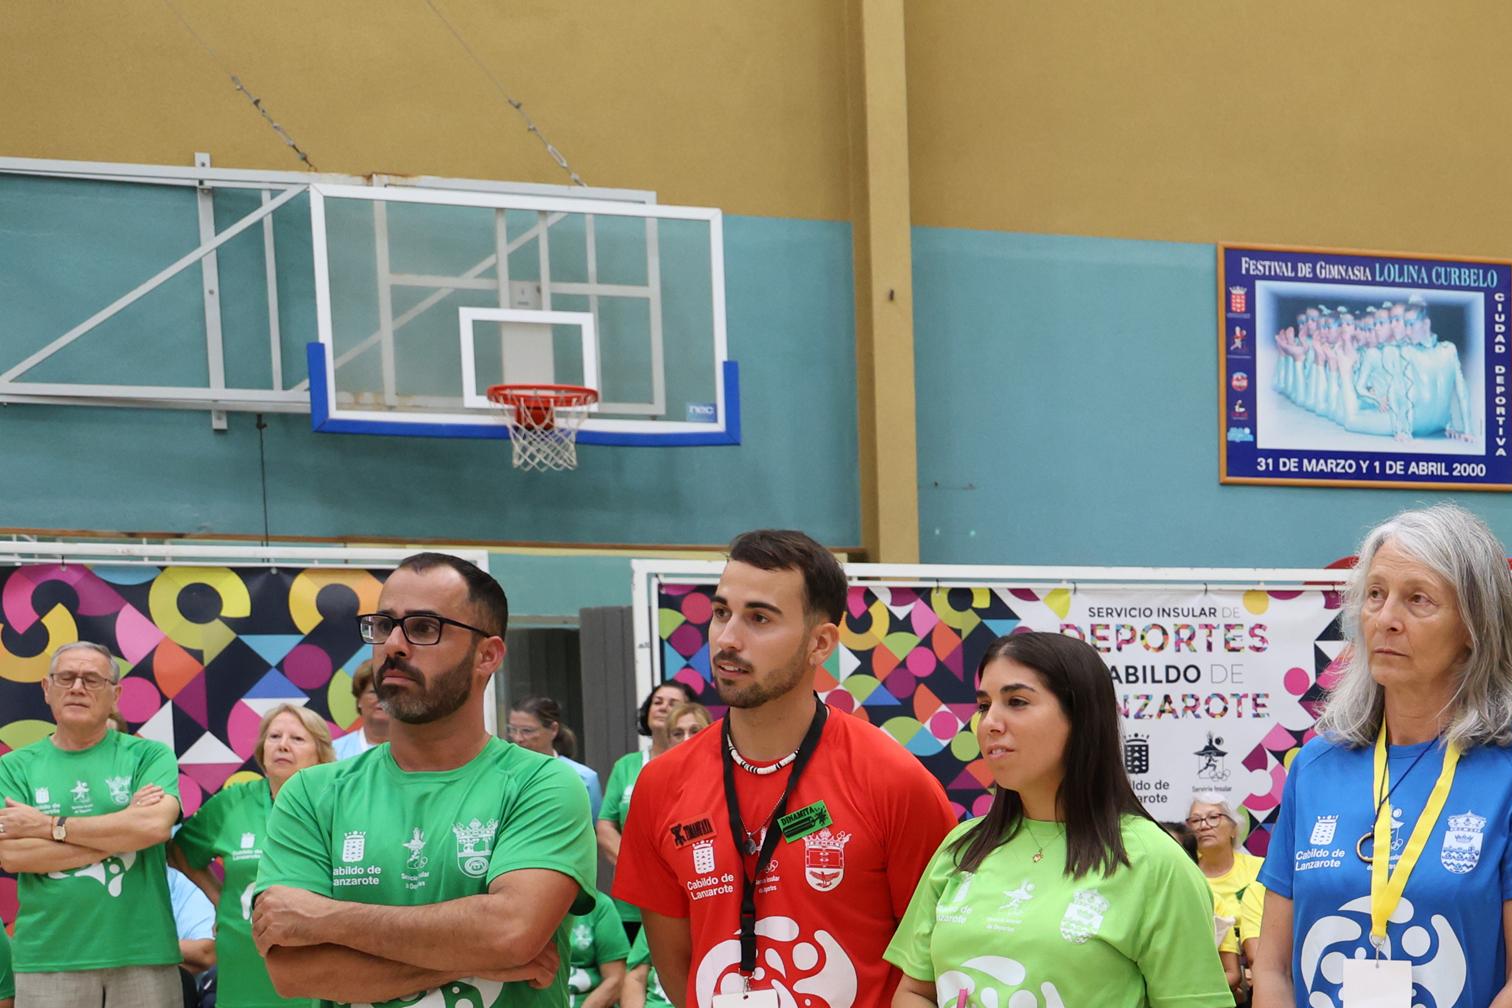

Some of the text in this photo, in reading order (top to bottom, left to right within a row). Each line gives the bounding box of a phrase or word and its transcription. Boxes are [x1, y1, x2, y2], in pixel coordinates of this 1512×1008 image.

[1241, 257, 1497, 288] FESTIVAL DE GIMNASIA LOLINA CURBELO
[1494, 293, 1507, 456] CIUDAD DEPORTIVA
[1256, 457, 1486, 477] 31 DE MARZO Y 1 DE ABRIL 2000
[1088, 607, 1241, 618] SERVICIO INSULAR DE
[1110, 664, 1244, 684] ABILDO DE
[1154, 780, 1170, 790] de
[1295, 848, 1345, 860] Cabildo de
[333, 865, 381, 876] abildo de
[1295, 860, 1341, 871] Lanzarote
[333, 876, 380, 886] anzarote
[687, 873, 734, 891] Cabildo de
